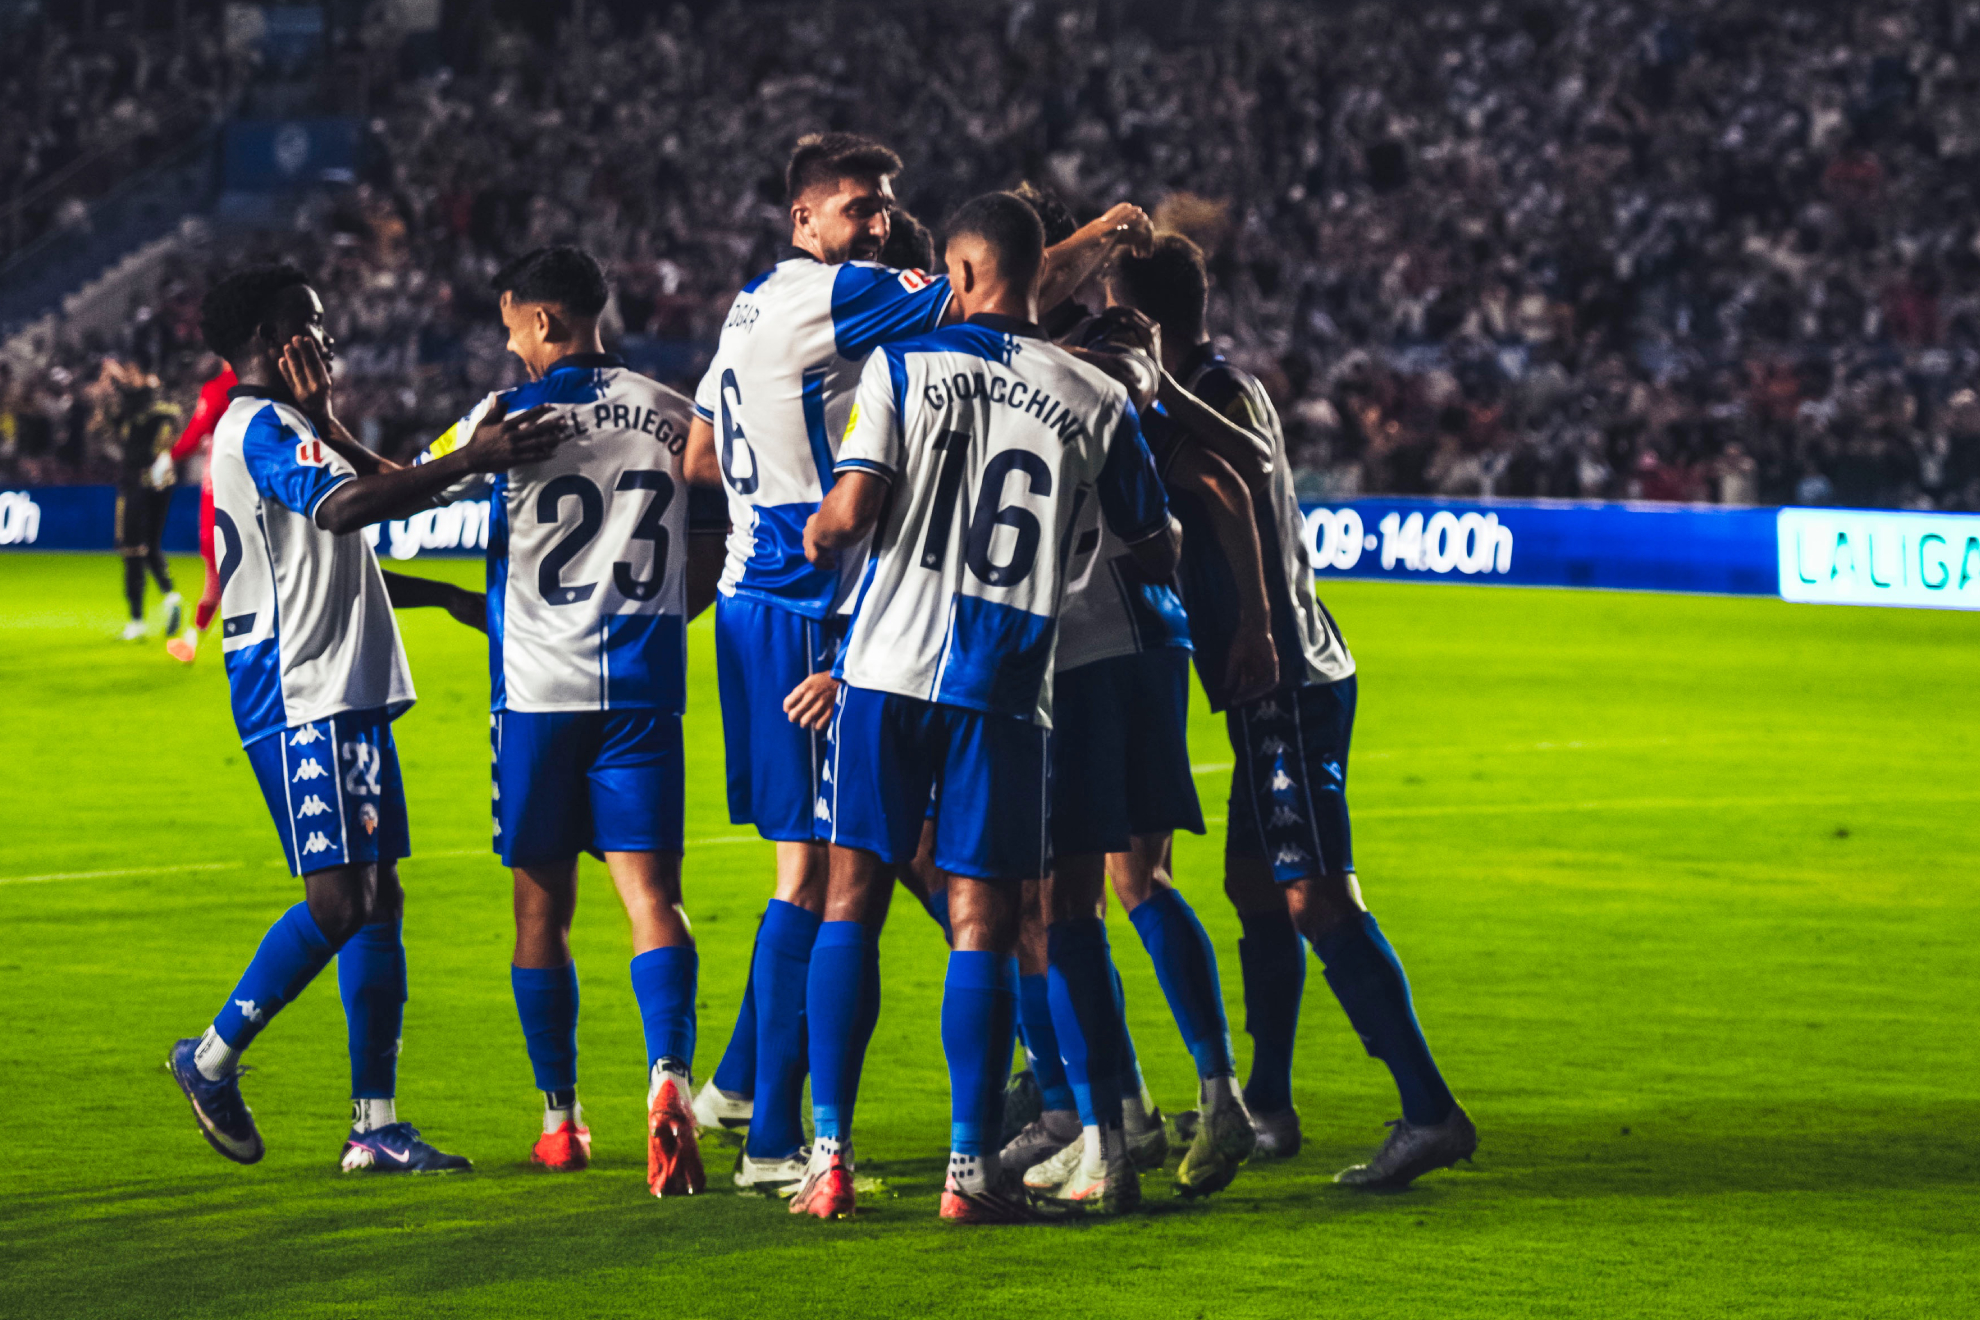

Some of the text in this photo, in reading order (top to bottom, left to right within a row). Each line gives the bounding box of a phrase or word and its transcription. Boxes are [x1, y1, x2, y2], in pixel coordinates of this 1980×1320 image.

[594, 404, 687, 456] PRIEGO
[720, 368, 759, 495] 6
[537, 470, 675, 606] 23
[919, 428, 1053, 588] 16
[1796, 532, 1980, 591] LALIGA
[342, 742, 381, 795] 22
